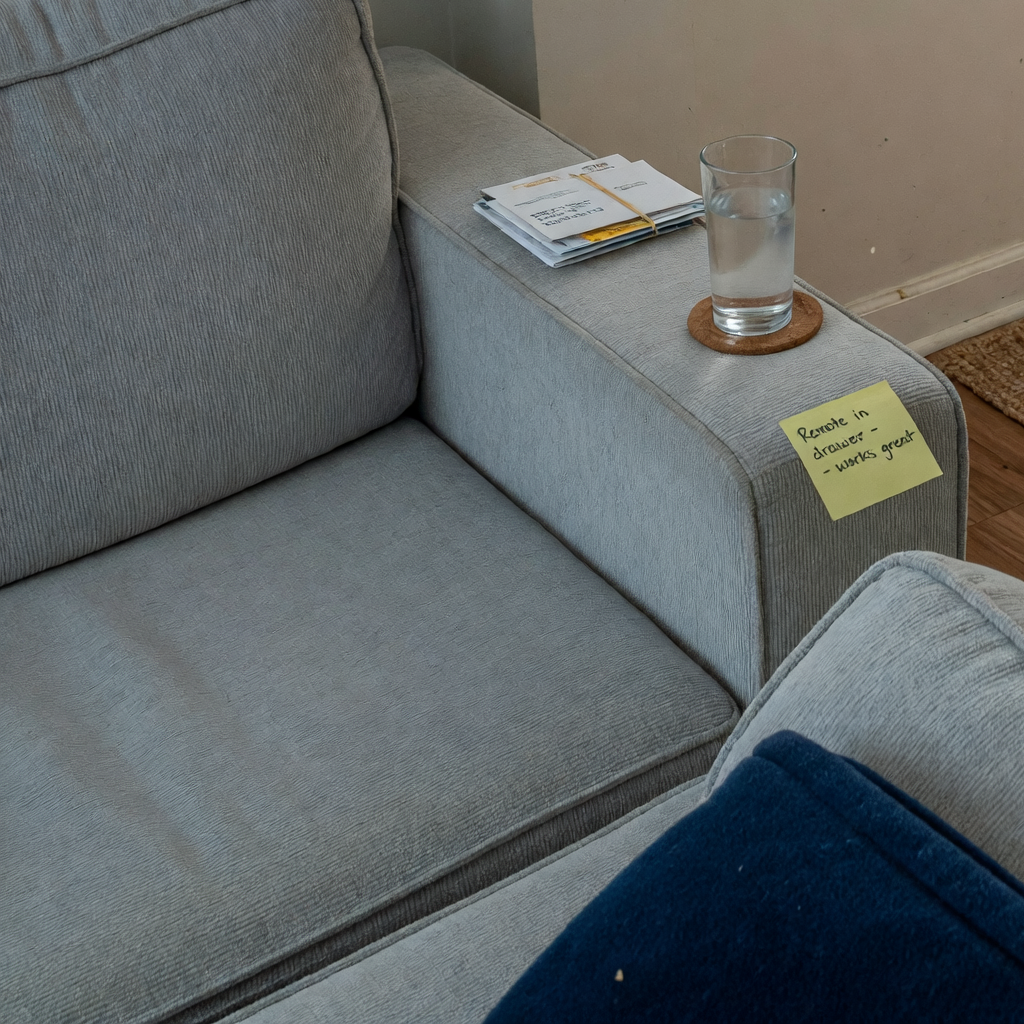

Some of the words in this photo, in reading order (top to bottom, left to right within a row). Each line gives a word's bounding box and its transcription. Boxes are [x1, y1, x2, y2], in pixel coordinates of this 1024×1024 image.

[797, 417, 848, 443] Remote
[852, 410, 869, 420] in
[813, 431, 863, 460] drawer
[835, 449, 877, 472] works
[881, 430, 915, 460] great
